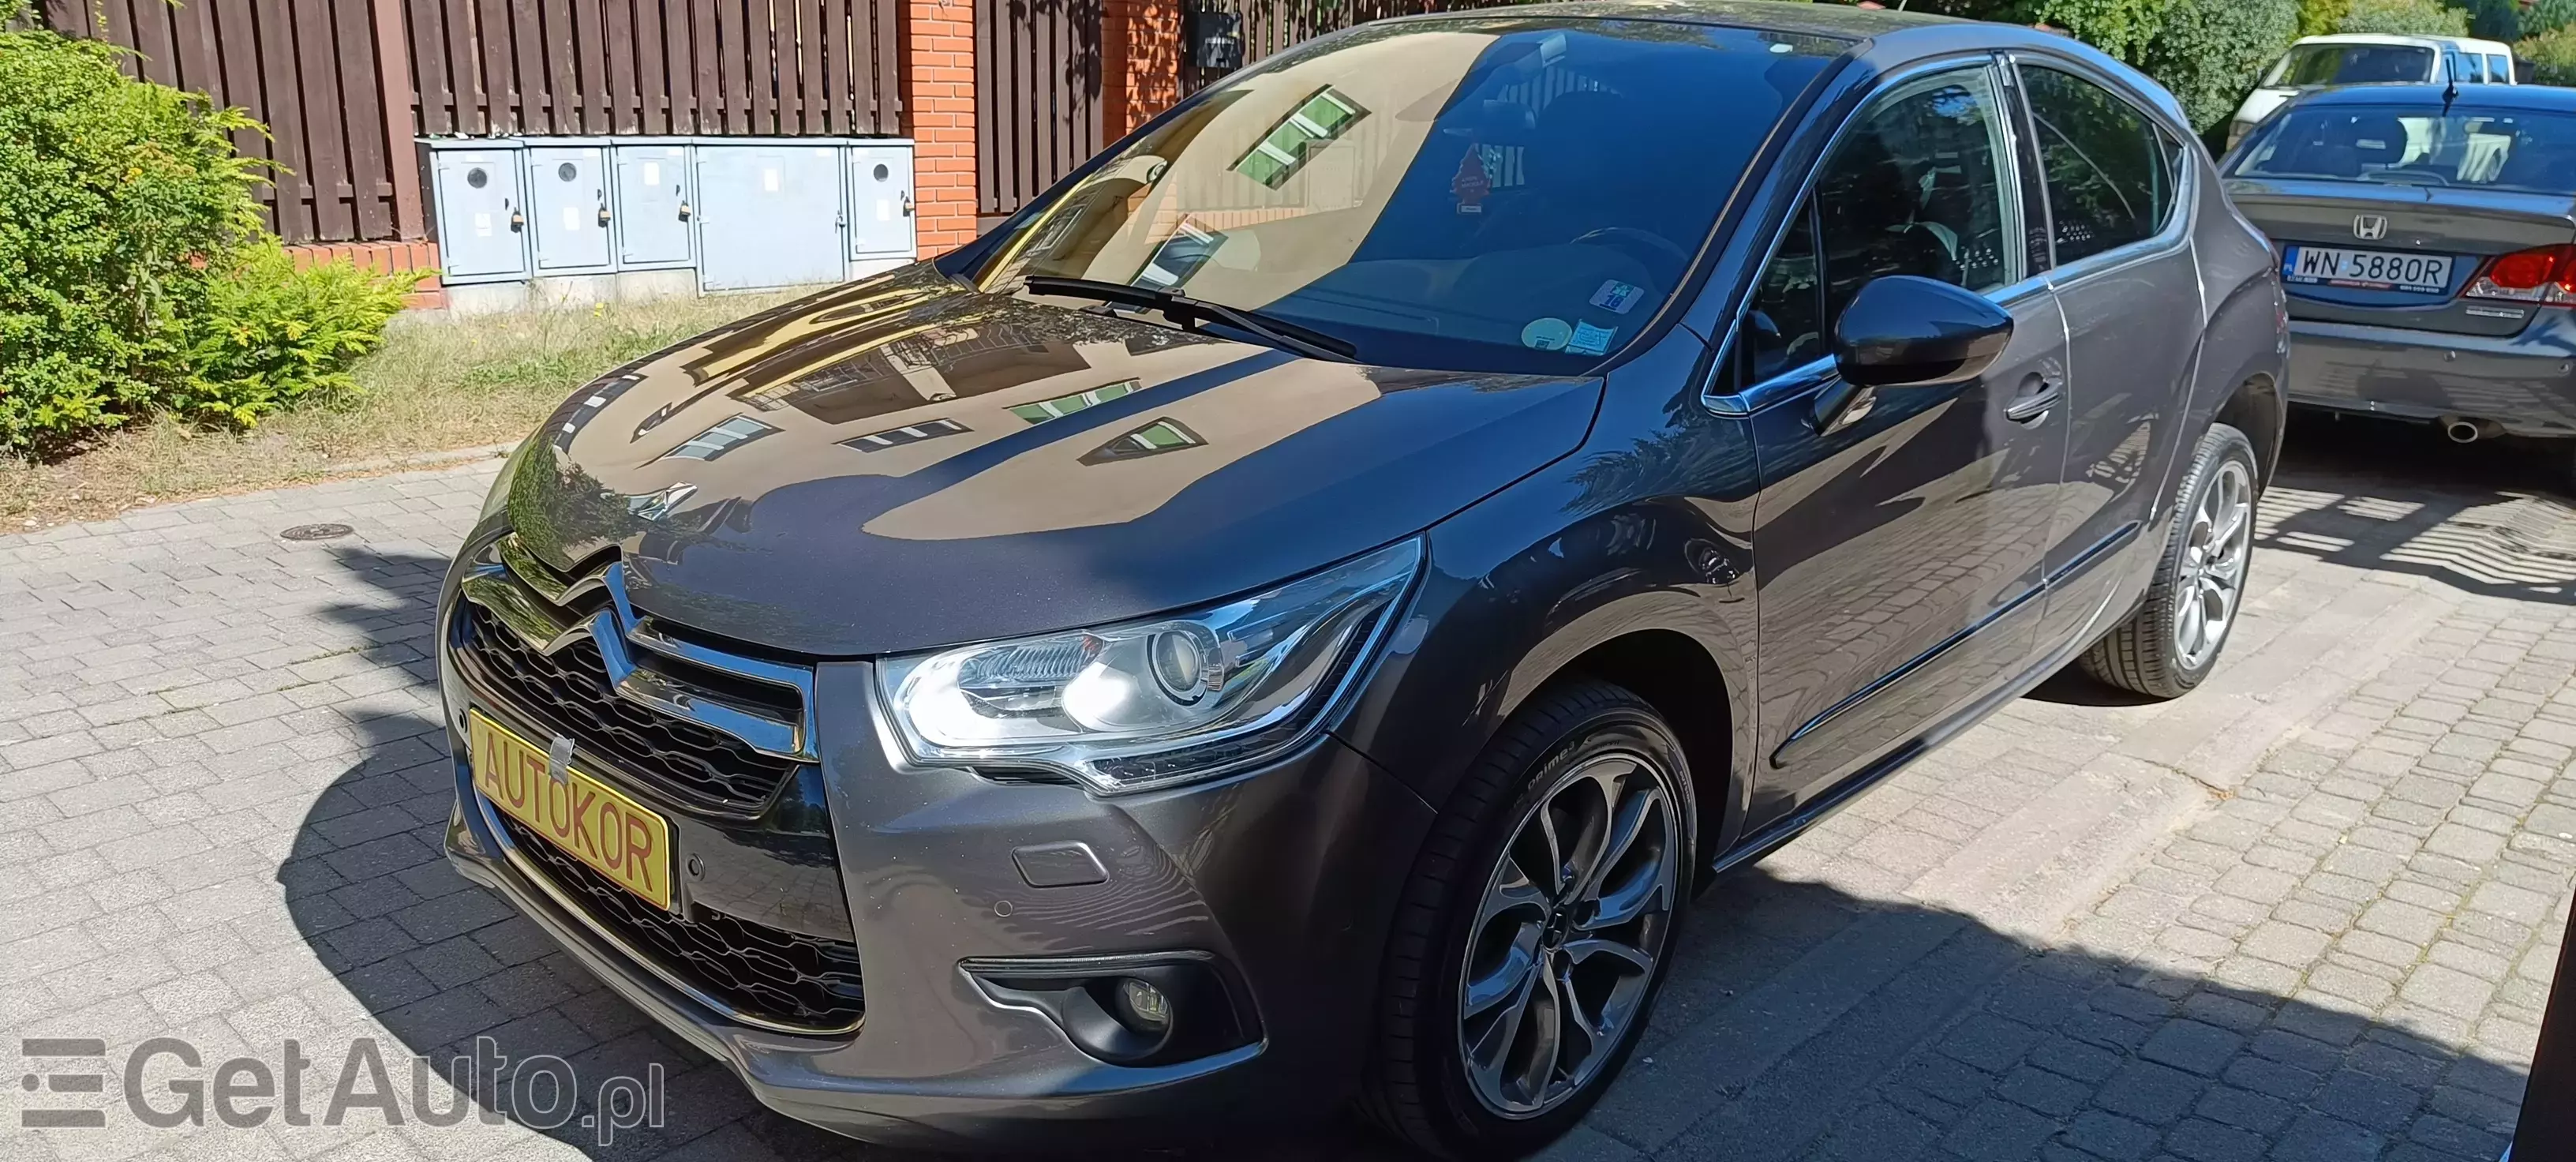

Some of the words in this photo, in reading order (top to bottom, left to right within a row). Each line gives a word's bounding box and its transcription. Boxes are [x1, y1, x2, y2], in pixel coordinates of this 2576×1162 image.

[2302, 250, 2340, 276] WN
[2349, 253, 2443, 285] 5880R
[484, 732, 653, 893] AUTOKOR
